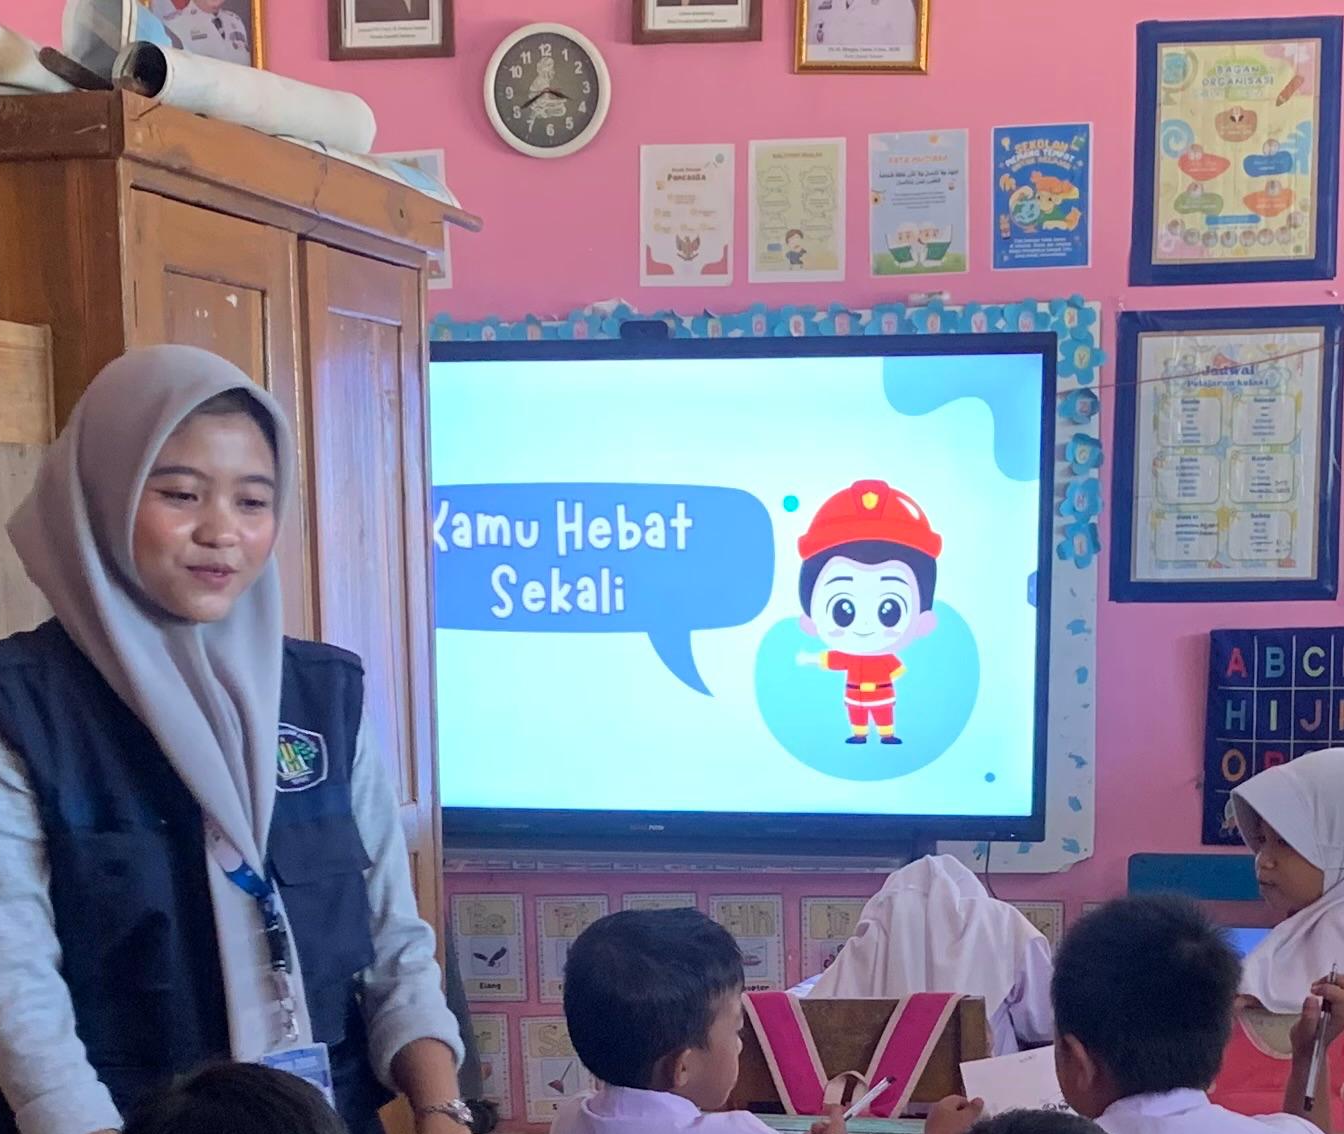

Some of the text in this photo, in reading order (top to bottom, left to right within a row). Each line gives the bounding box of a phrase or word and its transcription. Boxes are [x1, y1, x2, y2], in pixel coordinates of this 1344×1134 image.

[538, 43, 552, 57] 12
[561, 48, 569, 61] 1
[520, 51, 532, 64] 11
[509, 65, 523, 78] 10
[574, 61, 584, 74] 2
[1216, 65, 1260, 74] BAGAN
[582, 81, 591, 94] 3
[1201, 76, 1274, 87] ORGANISASI
[505, 86, 514, 99] 9
[512, 105, 522, 119] 8
[578, 101, 587, 113] 4
[526, 119, 535, 133] 7
[545, 123, 555, 137] 6
[565, 116, 574, 130] 5
[556, 500, 693, 558] Hebat
[489, 564, 626, 619] Sekali
[1225, 647, 1248, 678] A
[1265, 647, 1286, 678] B
[1302, 646, 1326, 677] C
[1225, 700, 1246, 731] H
[1269, 700, 1278, 731] I
[1299, 699, 1323, 732] J
[1221, 748, 1247, 782] O
